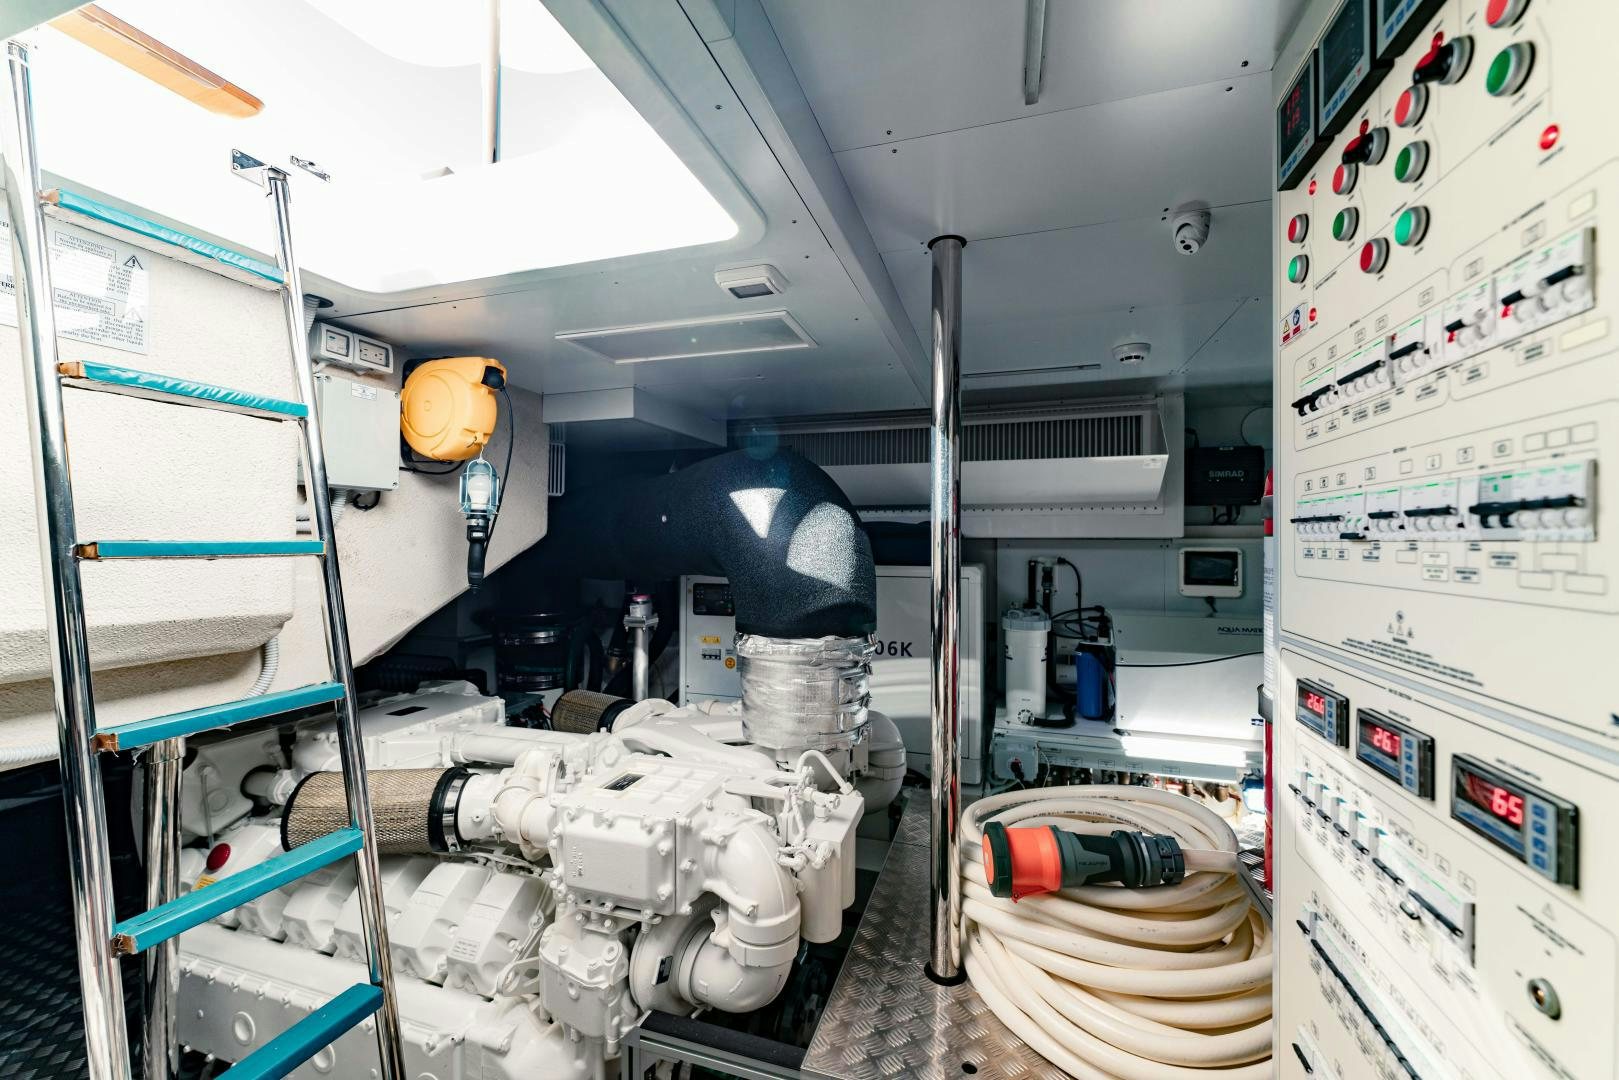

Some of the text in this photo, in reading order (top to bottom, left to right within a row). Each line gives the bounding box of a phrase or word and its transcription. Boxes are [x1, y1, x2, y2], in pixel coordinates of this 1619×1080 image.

[70, 291, 102, 304] ATTENTION
[1209, 470, 1245, 478] SIMRAD
[1492, 787, 1524, 825] 65
